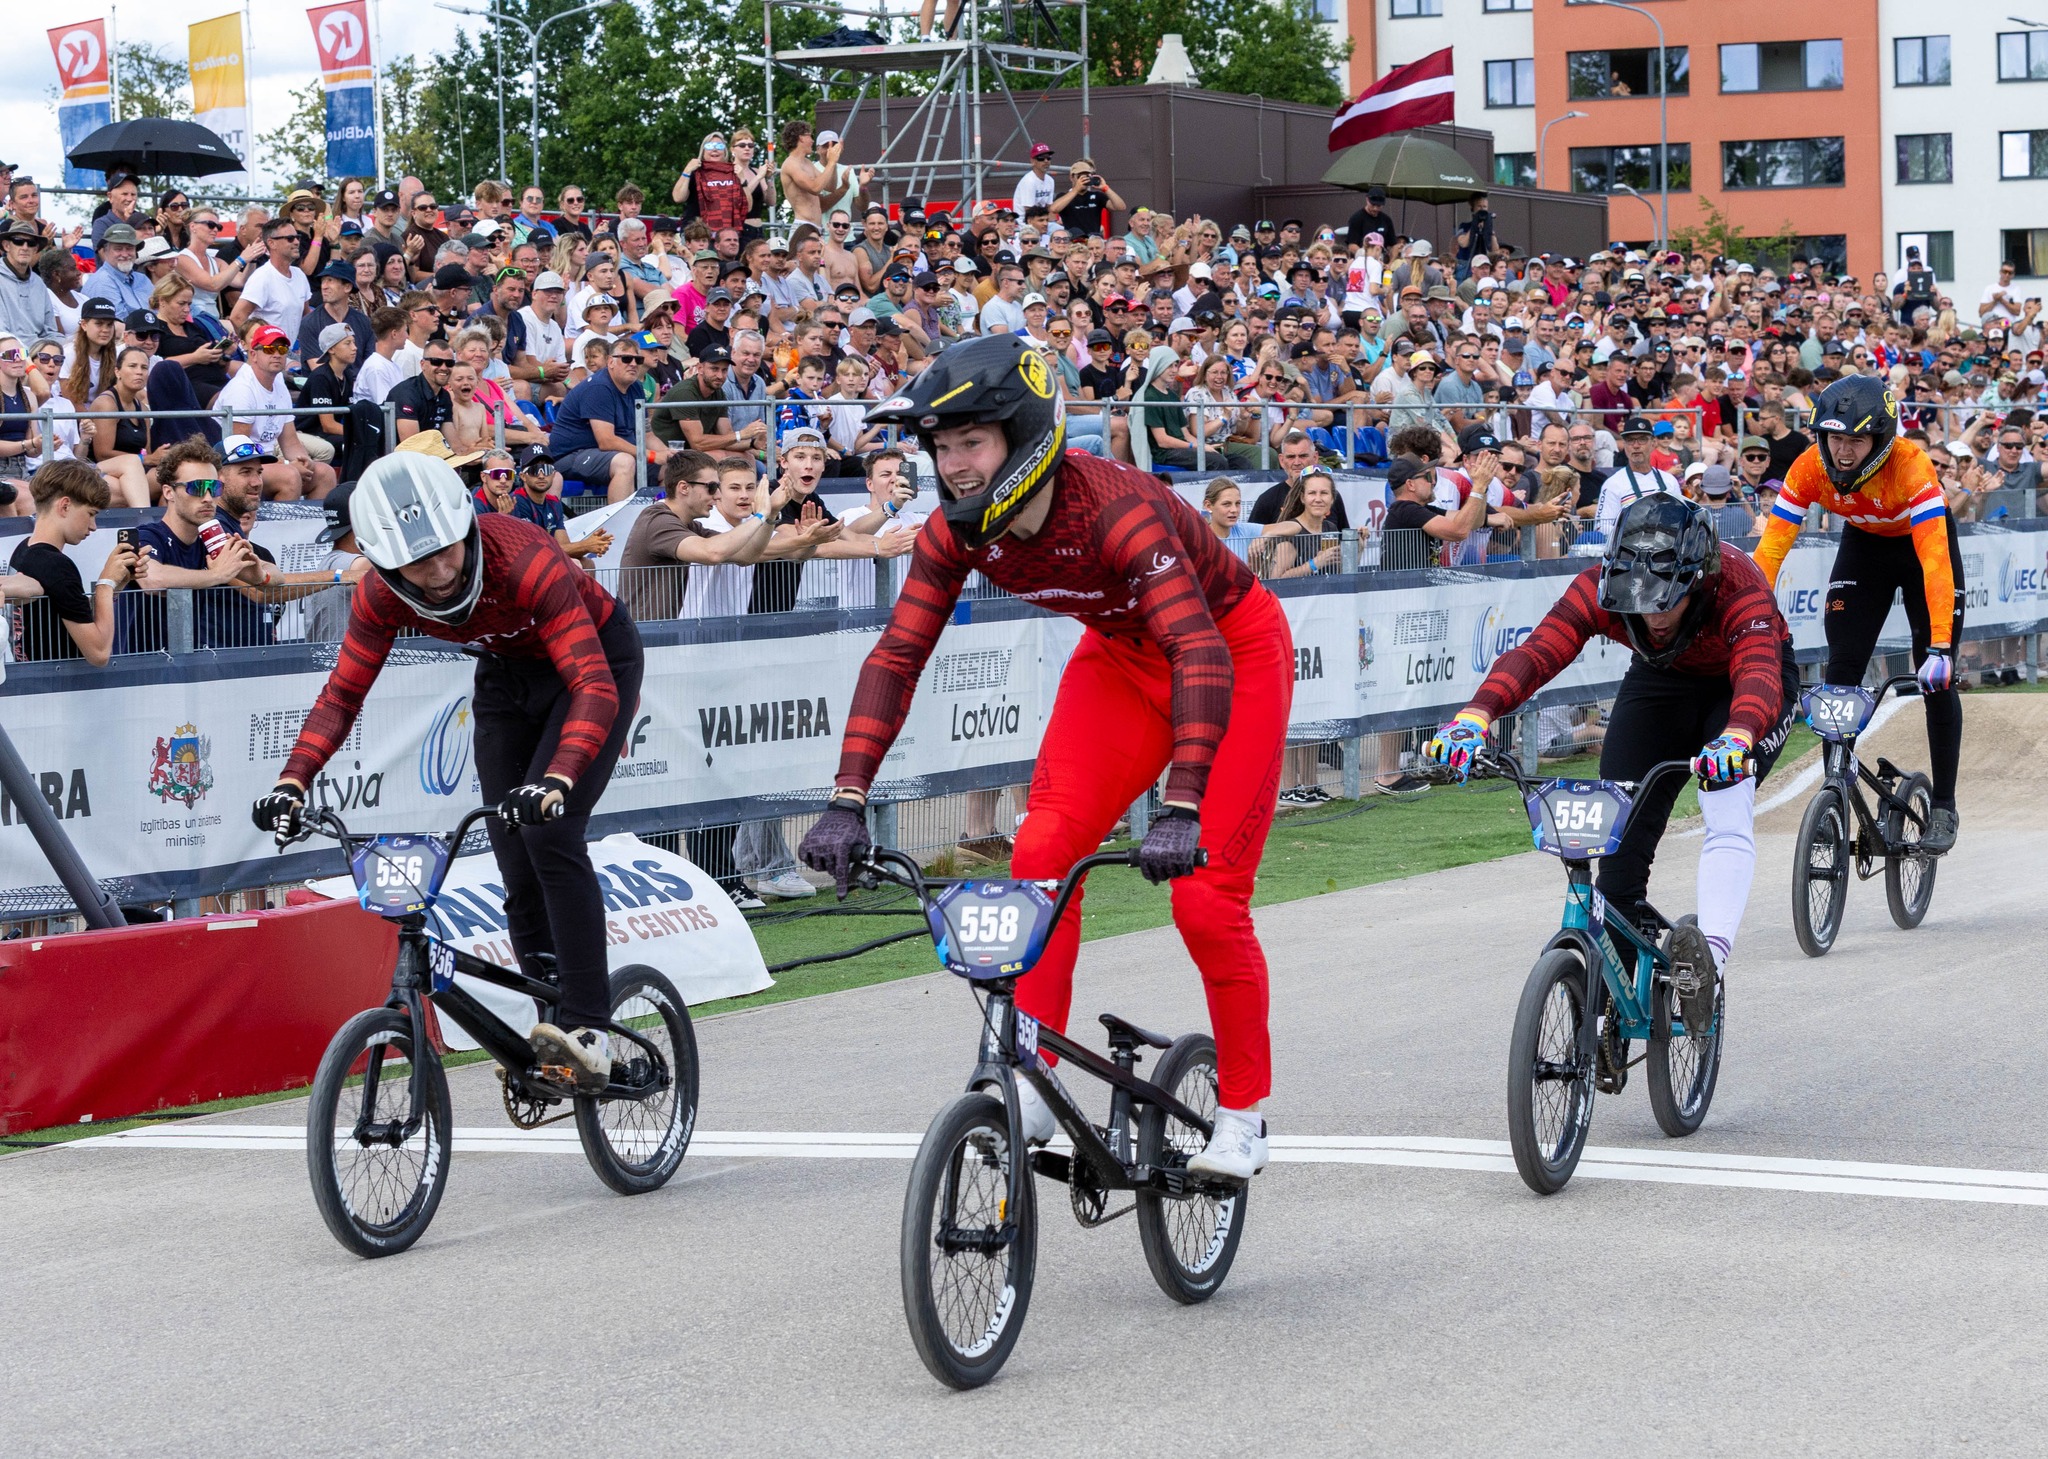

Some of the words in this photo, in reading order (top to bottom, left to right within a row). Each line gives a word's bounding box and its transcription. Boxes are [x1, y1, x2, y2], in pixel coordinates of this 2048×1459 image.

[1824, 421, 1842, 429] BELL
[995, 431, 1053, 501] STAYSTRONG
[411, 538, 436, 552] BELL
[1016, 588, 1105, 600] AYSTRONG
[2014, 568, 2037, 590] UEC
[1787, 589, 1820, 615] UEC
[1965, 581, 1989, 609] atvia
[1494, 626, 1534, 657] UEC
[1406, 647, 1455, 686] Latvia
[698, 696, 832, 749] VALMIERA
[951, 694, 1020, 742] Latvia
[1819, 698, 1855, 722] 524
[307, 760, 384, 813] tvia
[140, 817, 181, 835] Izglītības
[185, 819, 197, 830] un
[198, 814, 222, 829] zinātnes
[1555, 800, 1604, 831] 554
[165, 833, 206, 848] ministrija
[376, 855, 423, 887] 556
[626, 904, 719, 941] CENTRS
[959, 905, 1020, 943] 558
[429, 941, 455, 980] 556
[1600, 931, 1637, 1000] MEYBO
[1018, 1010, 1039, 1056] 558
